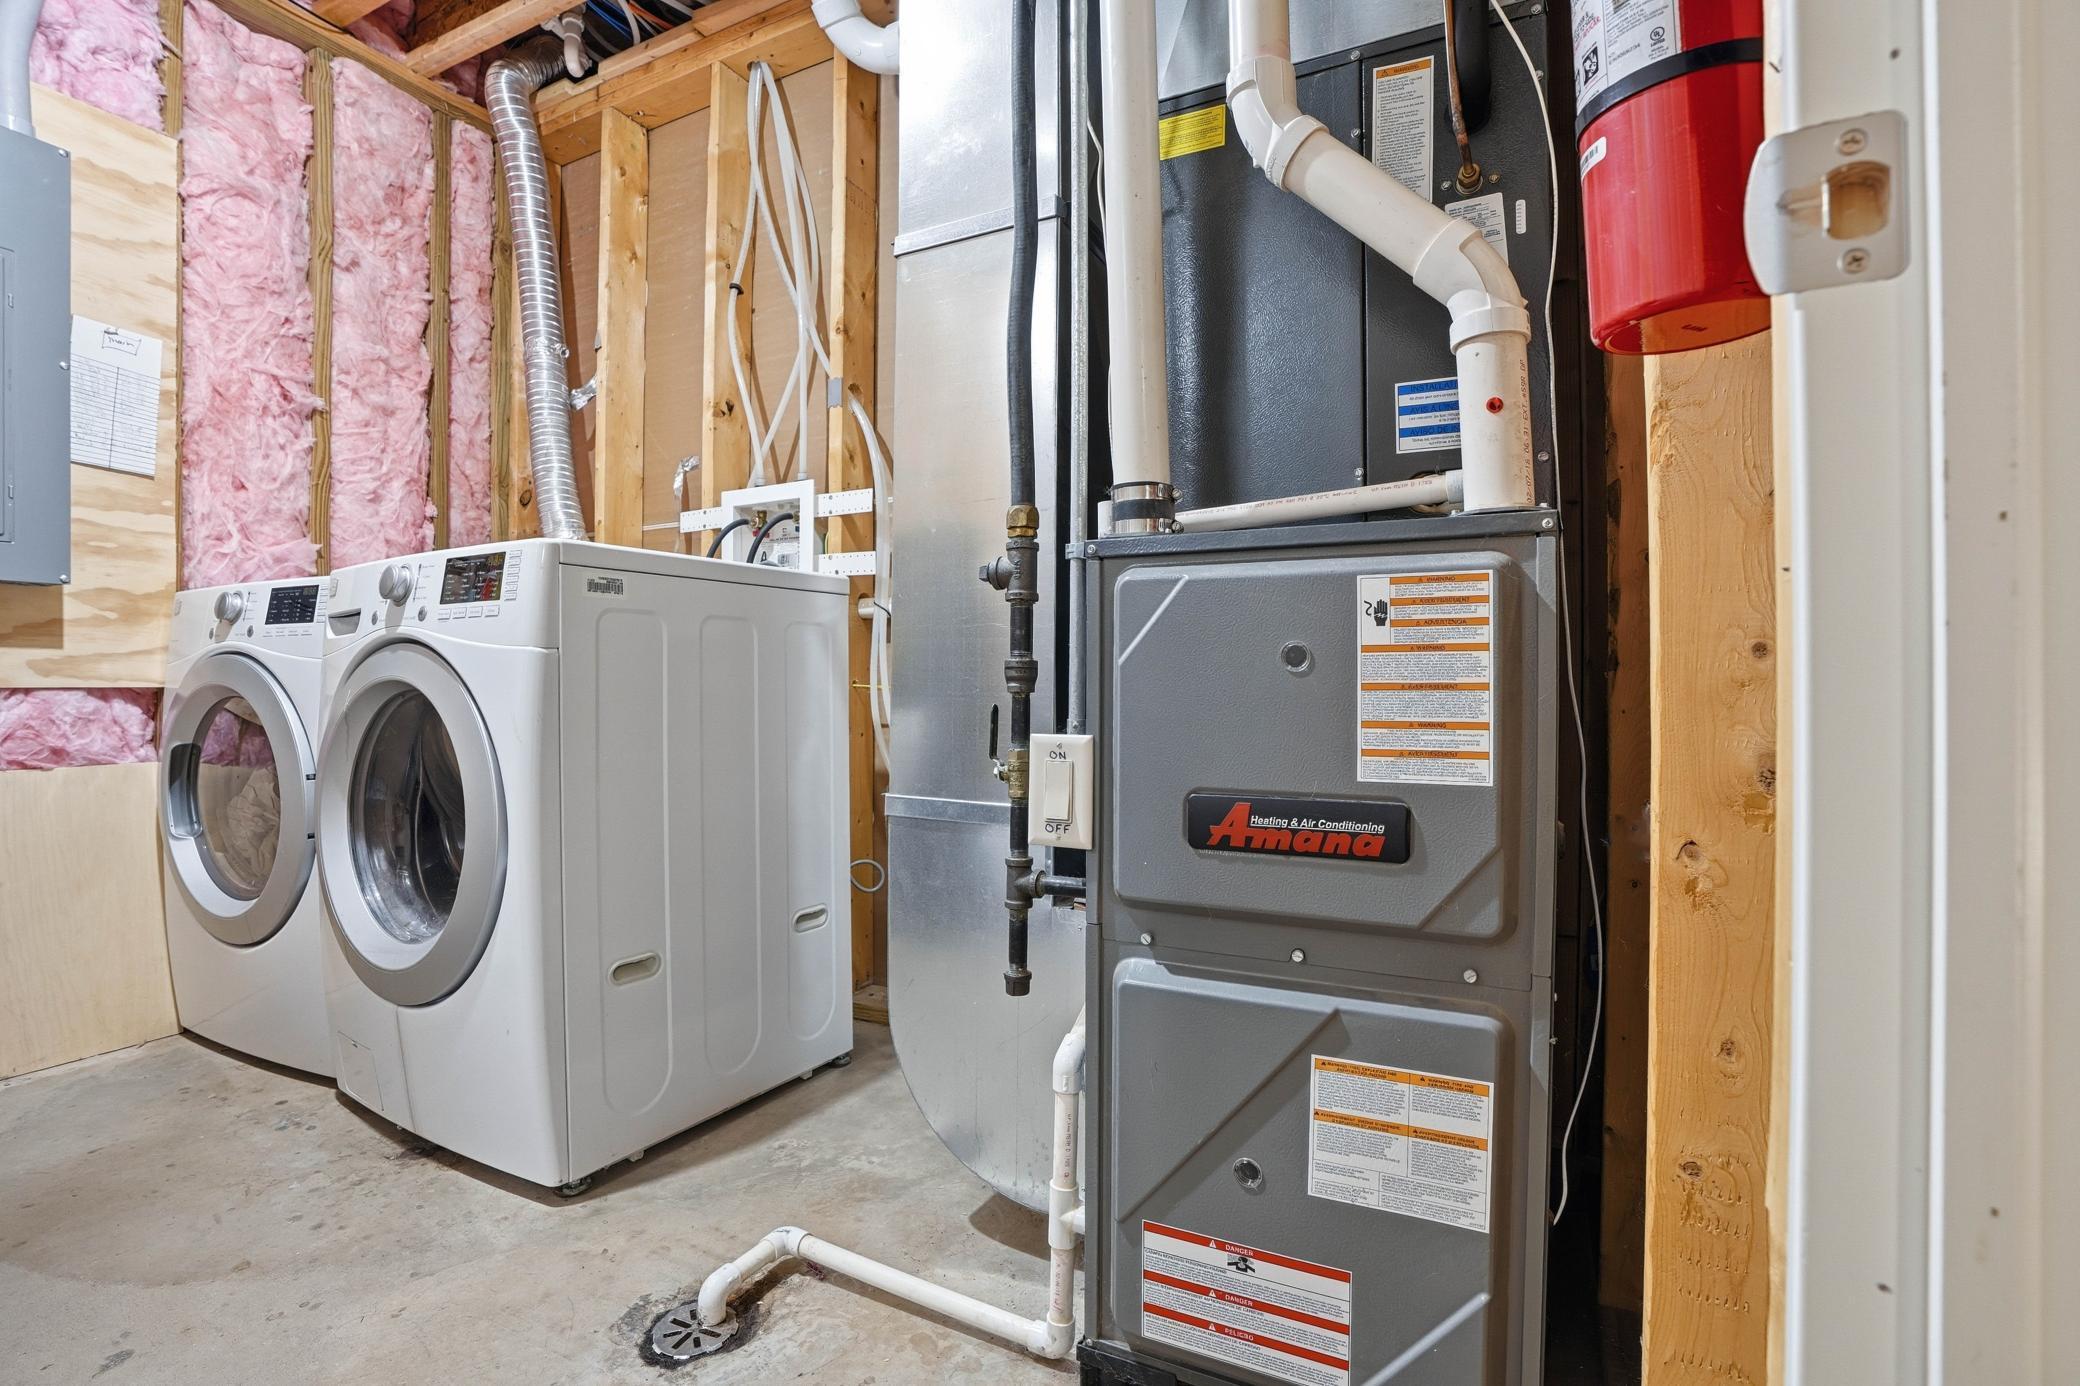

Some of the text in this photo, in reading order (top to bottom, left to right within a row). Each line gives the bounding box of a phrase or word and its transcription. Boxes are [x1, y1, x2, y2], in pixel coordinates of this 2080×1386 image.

[1049, 750, 1067, 760] ON
[1045, 823, 1071, 834] OFF
[1207, 802, 1386, 857] Amana
[1251, 815, 1385, 834] Heating & Air Conditioning
[1225, 1244, 1254, 1257] DANGER
[1225, 1294, 1253, 1307] DANGER
[1224, 1327, 1254, 1341] PELIGRO
